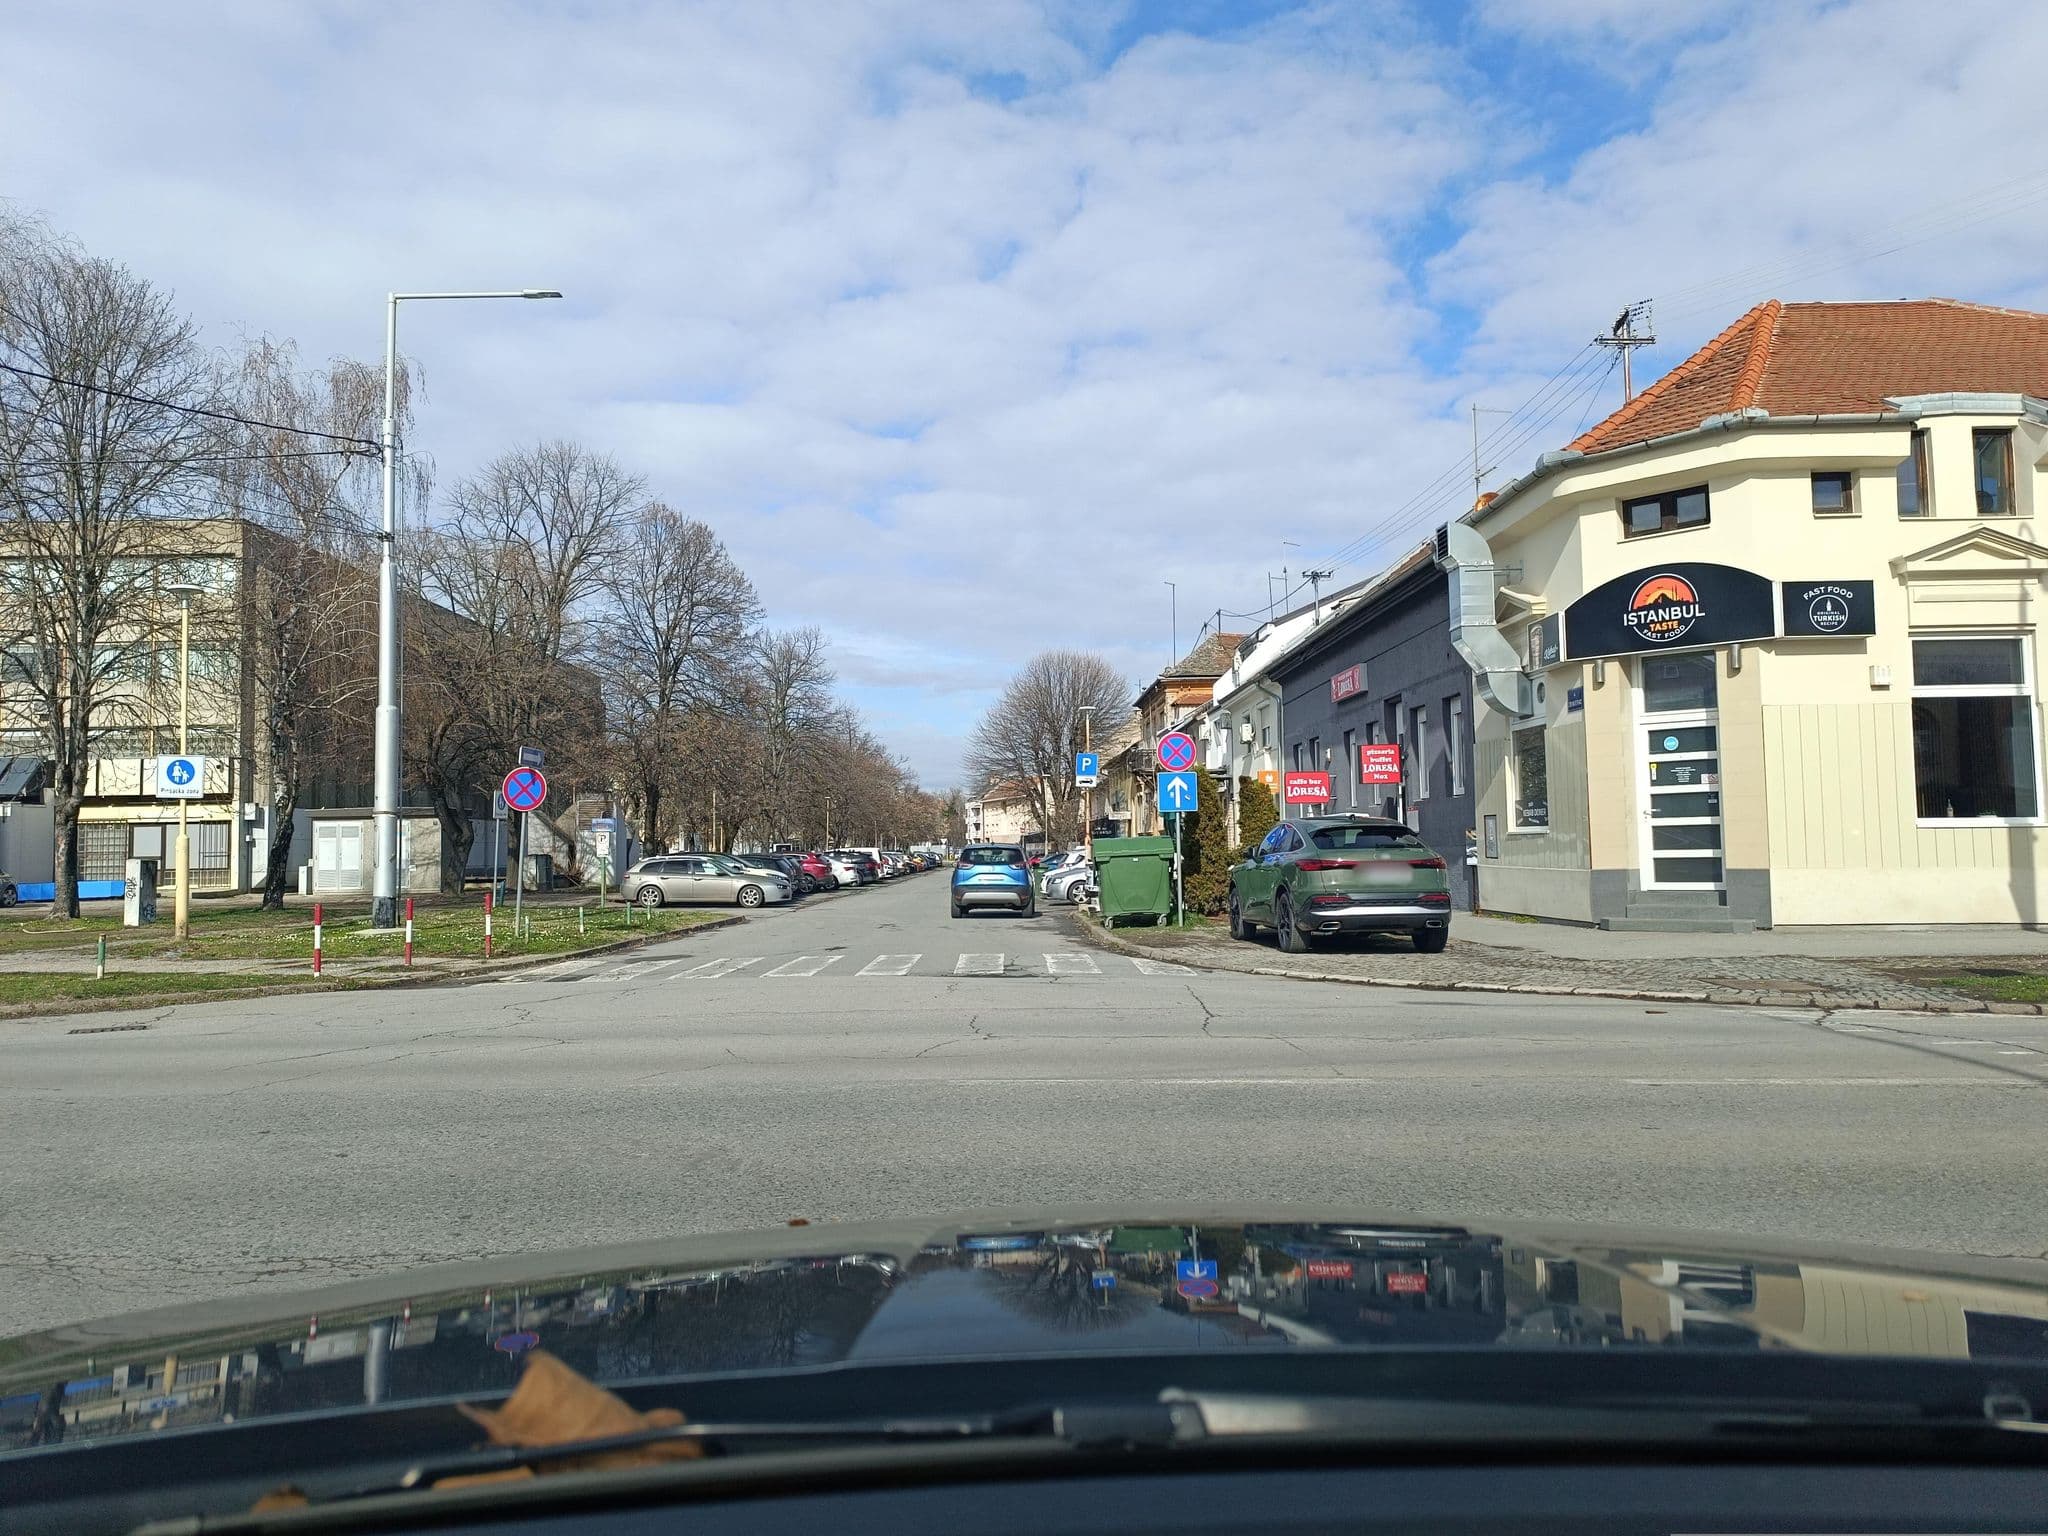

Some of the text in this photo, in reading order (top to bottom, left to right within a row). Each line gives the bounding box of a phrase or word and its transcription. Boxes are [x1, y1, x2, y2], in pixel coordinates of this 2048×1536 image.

[1803, 586, 1853, 600] FAST FOOD
[1623, 604, 1706, 626] ISTANBUL
[1642, 625, 1685, 639] FAST FOOD
[1649, 621, 1679, 632] TASTE
[1082, 757, 1092, 772] P
[1363, 763, 1399, 773] LORESA
[1287, 785, 1328, 797] LORESA
[599, 834, 607, 843] P
